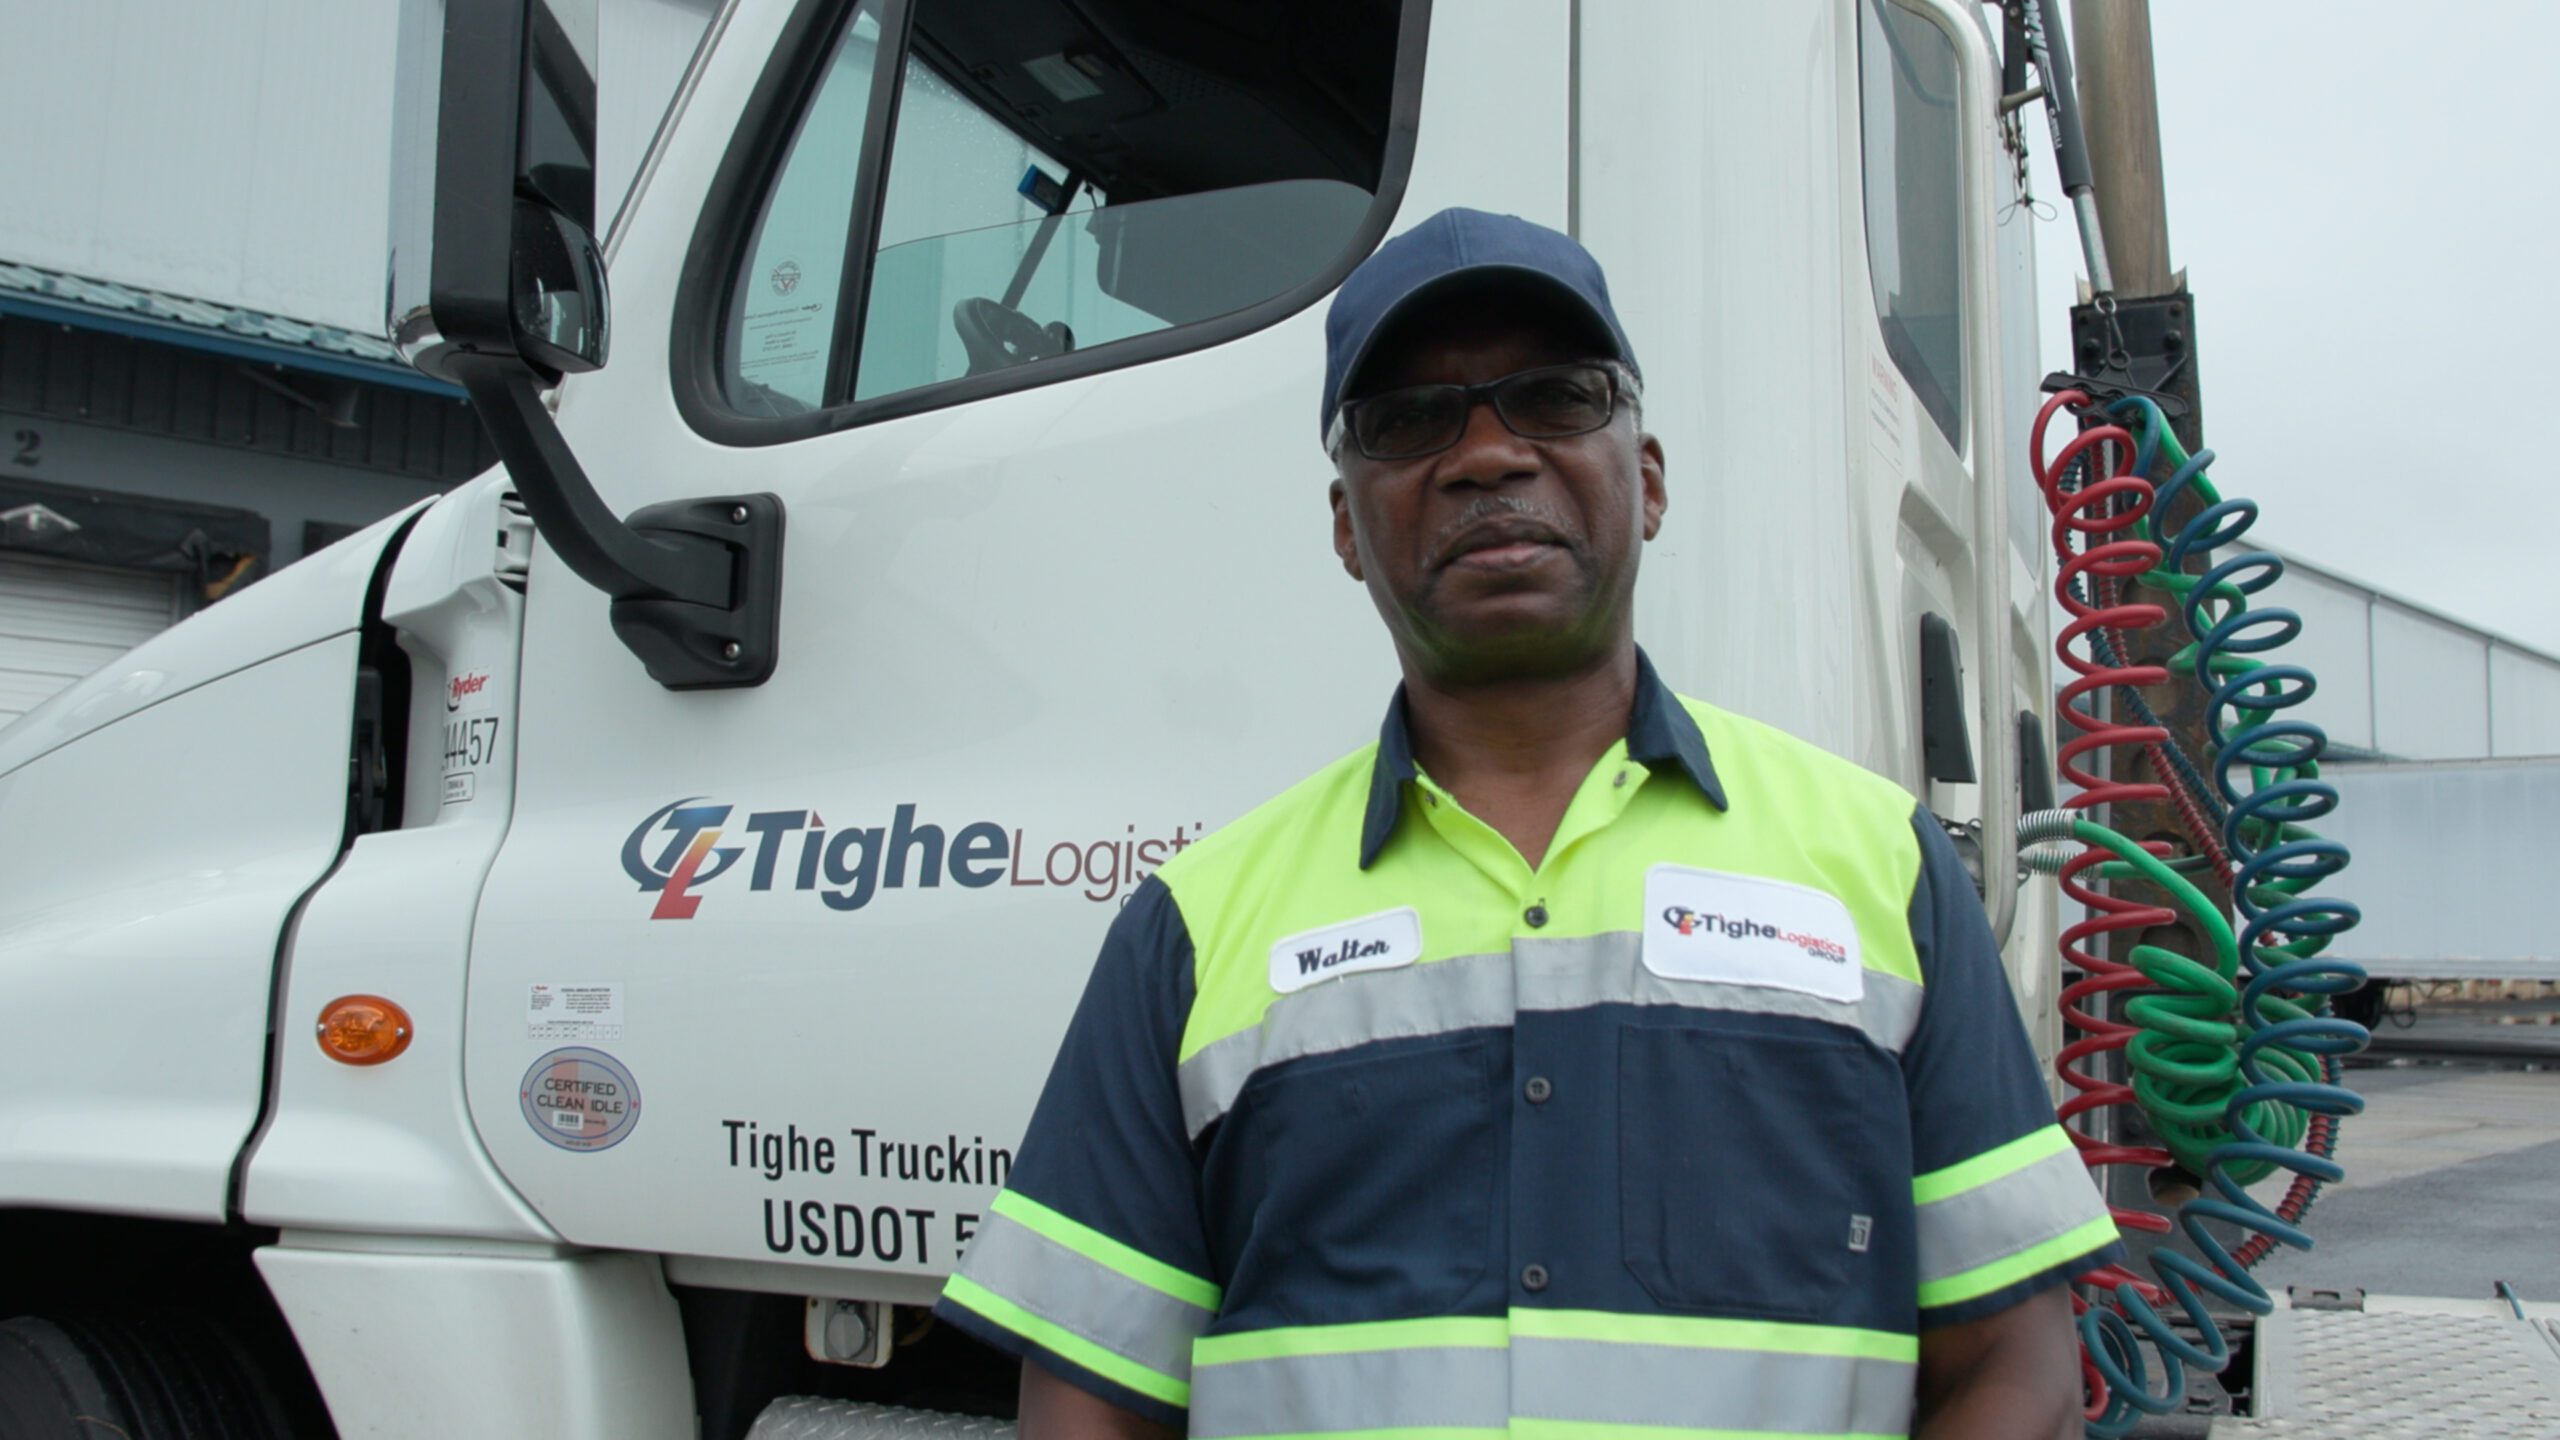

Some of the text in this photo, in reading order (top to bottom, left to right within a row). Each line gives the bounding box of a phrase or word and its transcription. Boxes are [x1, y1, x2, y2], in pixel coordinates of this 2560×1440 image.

[13, 429, 41, 467] 2
[1295, 938, 1390, 975] Walter
[536, 1094, 624, 1114] CLEAN IDLE
[544, 1077, 617, 1097] CERTIFIED
[722, 1120, 835, 1181] Tighe
[764, 1198, 935, 1264] USDOT
